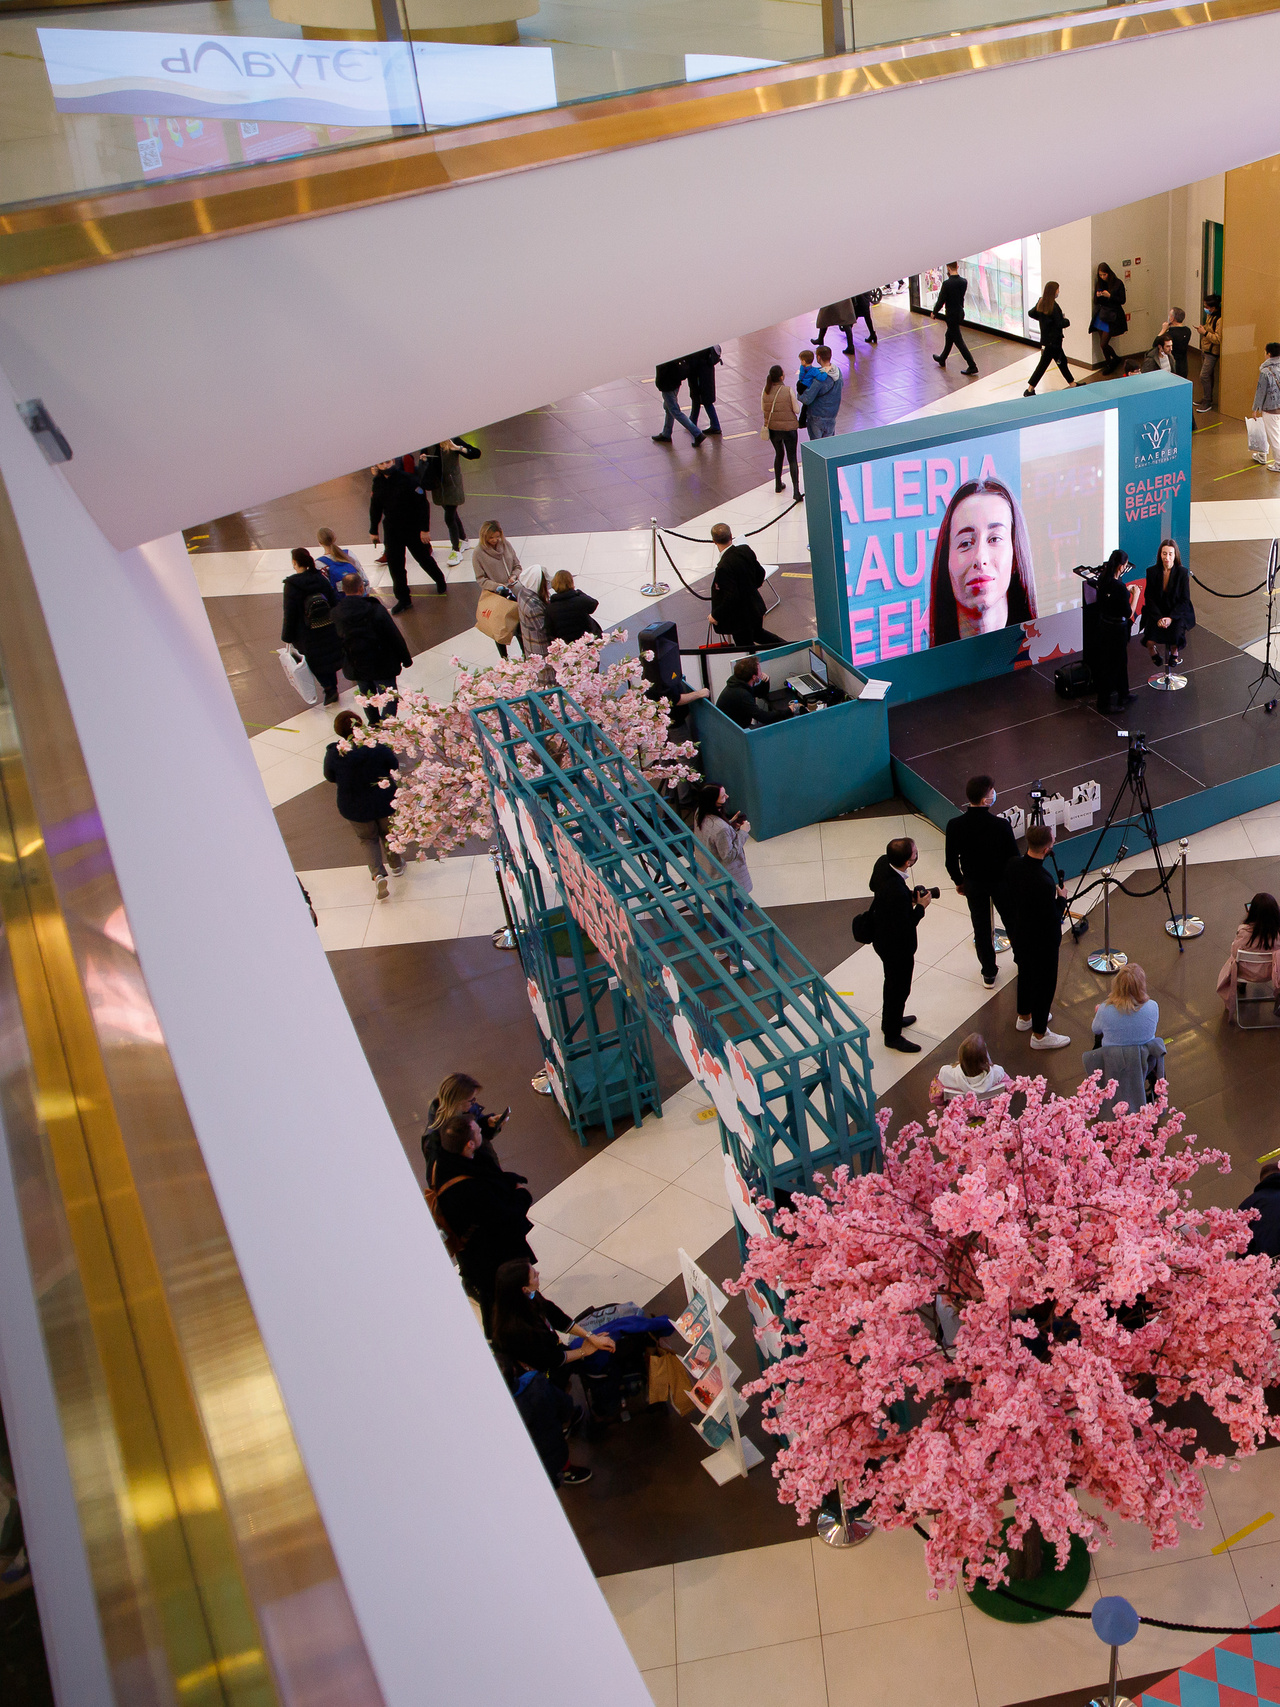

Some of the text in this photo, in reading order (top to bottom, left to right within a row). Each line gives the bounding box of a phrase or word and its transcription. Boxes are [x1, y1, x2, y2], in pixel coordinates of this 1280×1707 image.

[1134, 447, 1178, 464] ГАЛЕРЕЯ
[1125, 470, 1186, 495] GALERIA
[1125, 484, 1180, 510] BEAUTY
[1125, 501, 1167, 523] WEEK
[552, 823, 635, 946] GALERIA
[558, 855, 629, 966] BEAUTY
